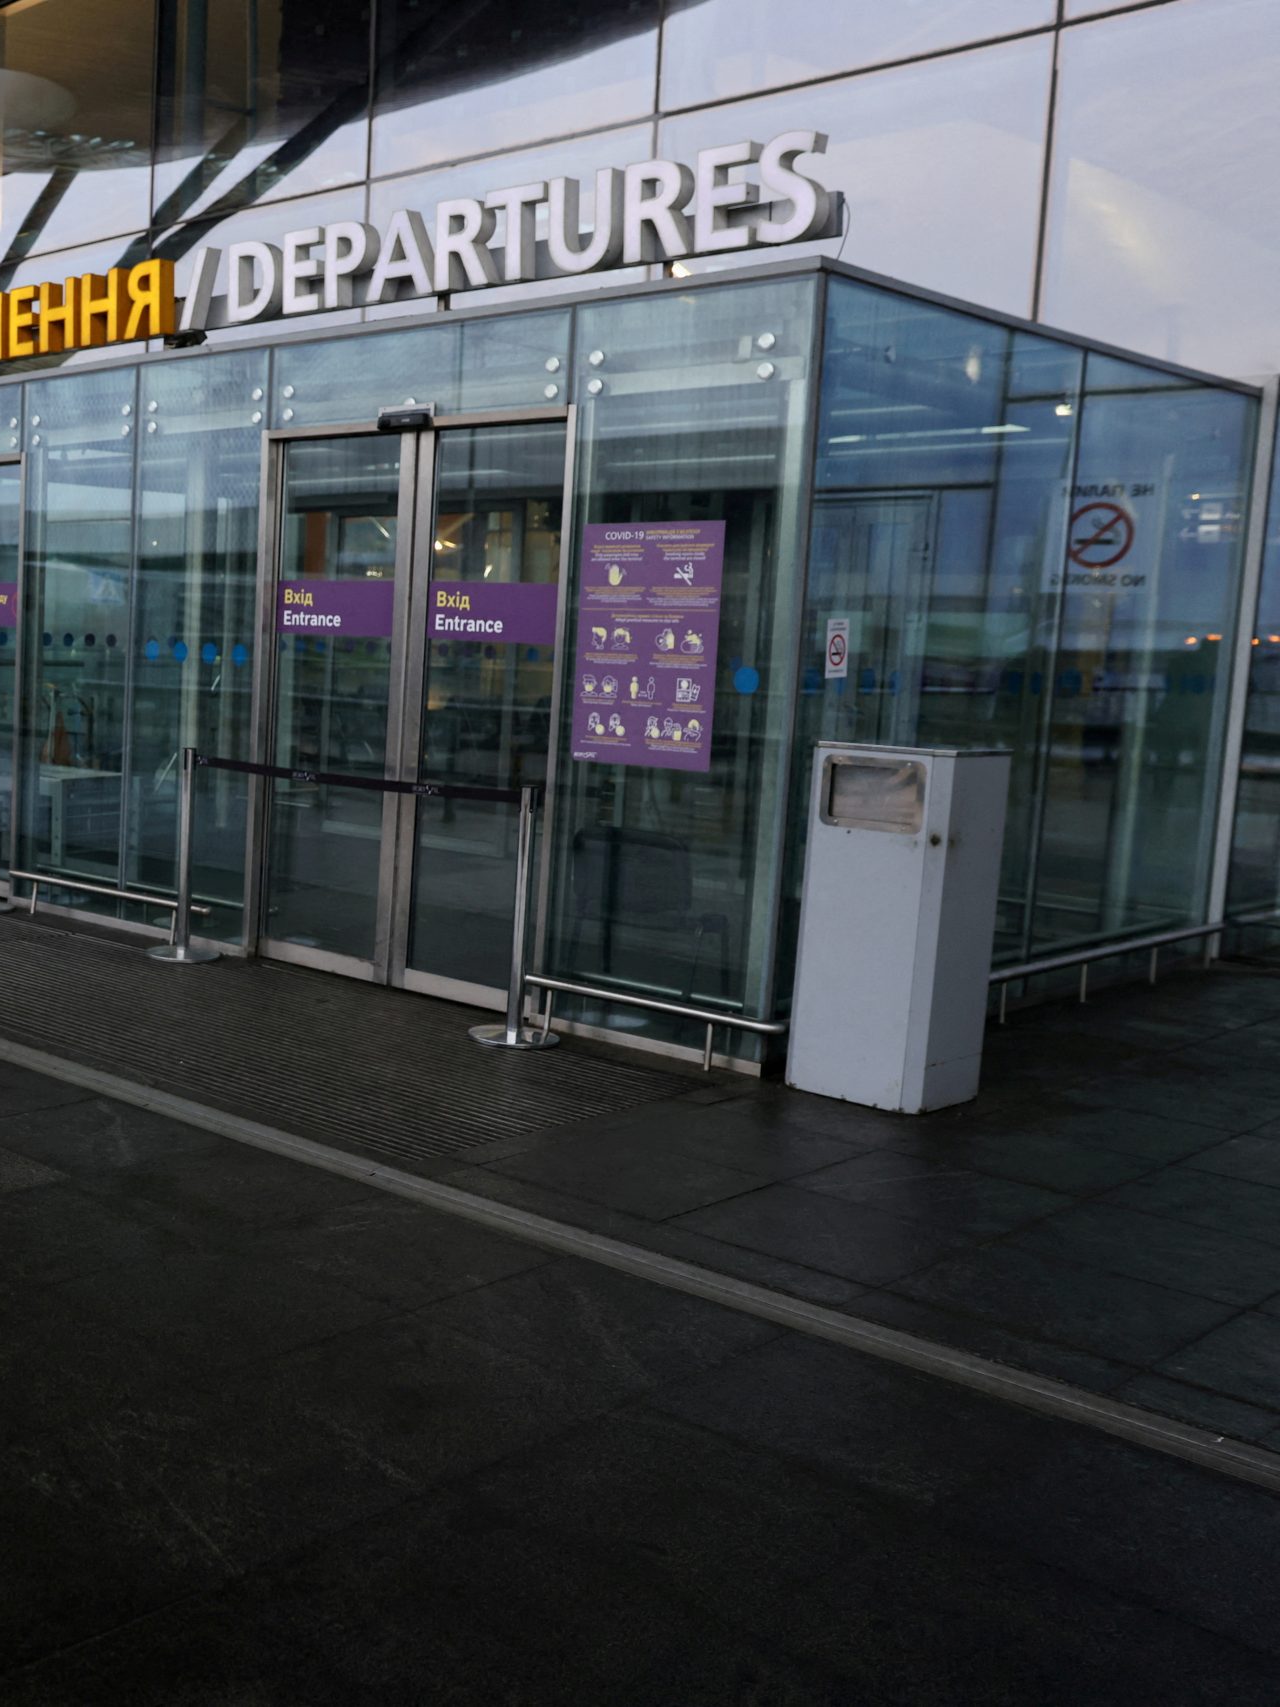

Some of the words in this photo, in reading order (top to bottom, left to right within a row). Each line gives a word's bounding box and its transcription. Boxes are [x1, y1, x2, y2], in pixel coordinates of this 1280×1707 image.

[605, 530, 645, 540] COVID-19
[284, 589, 313, 606] Вхід
[436, 591, 470, 610] Вхід
[283, 610, 342, 627] Entrance
[435, 614, 503, 633] Entrance
